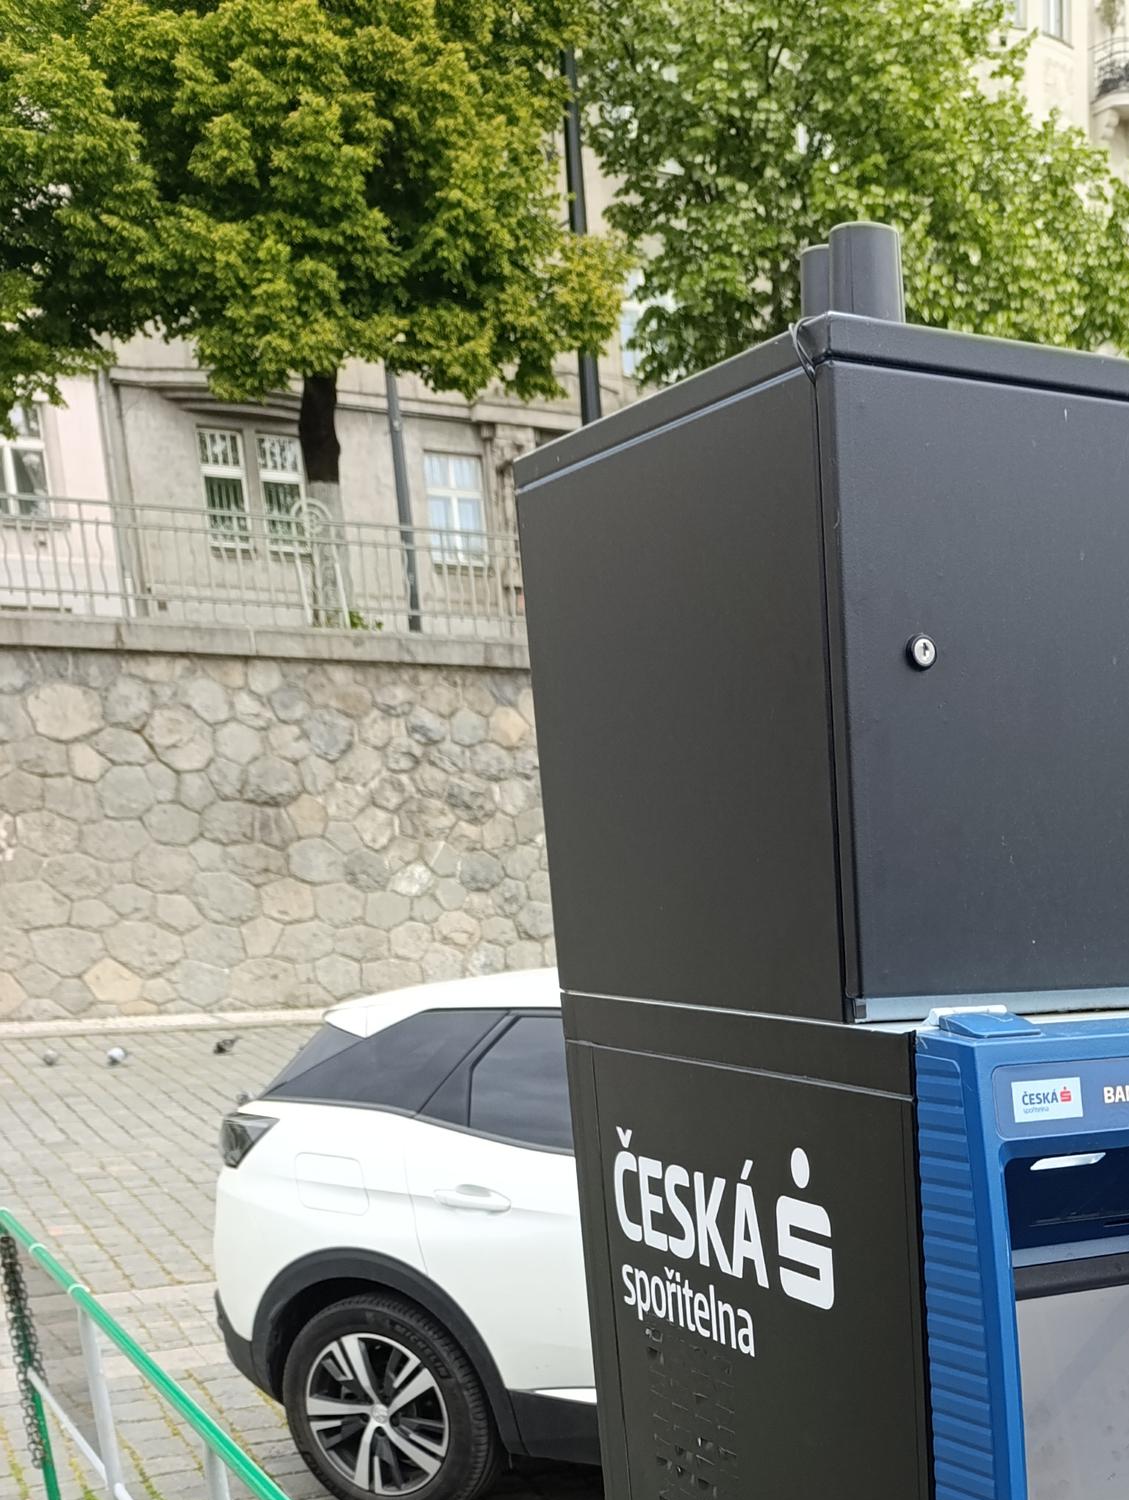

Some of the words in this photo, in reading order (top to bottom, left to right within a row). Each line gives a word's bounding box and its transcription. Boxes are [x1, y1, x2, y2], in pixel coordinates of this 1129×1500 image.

[1022, 1088, 1058, 1105] ČESKÁ
[614, 1126, 769, 1289] ČESKÁ
[622, 1264, 755, 1357] spořitelna
